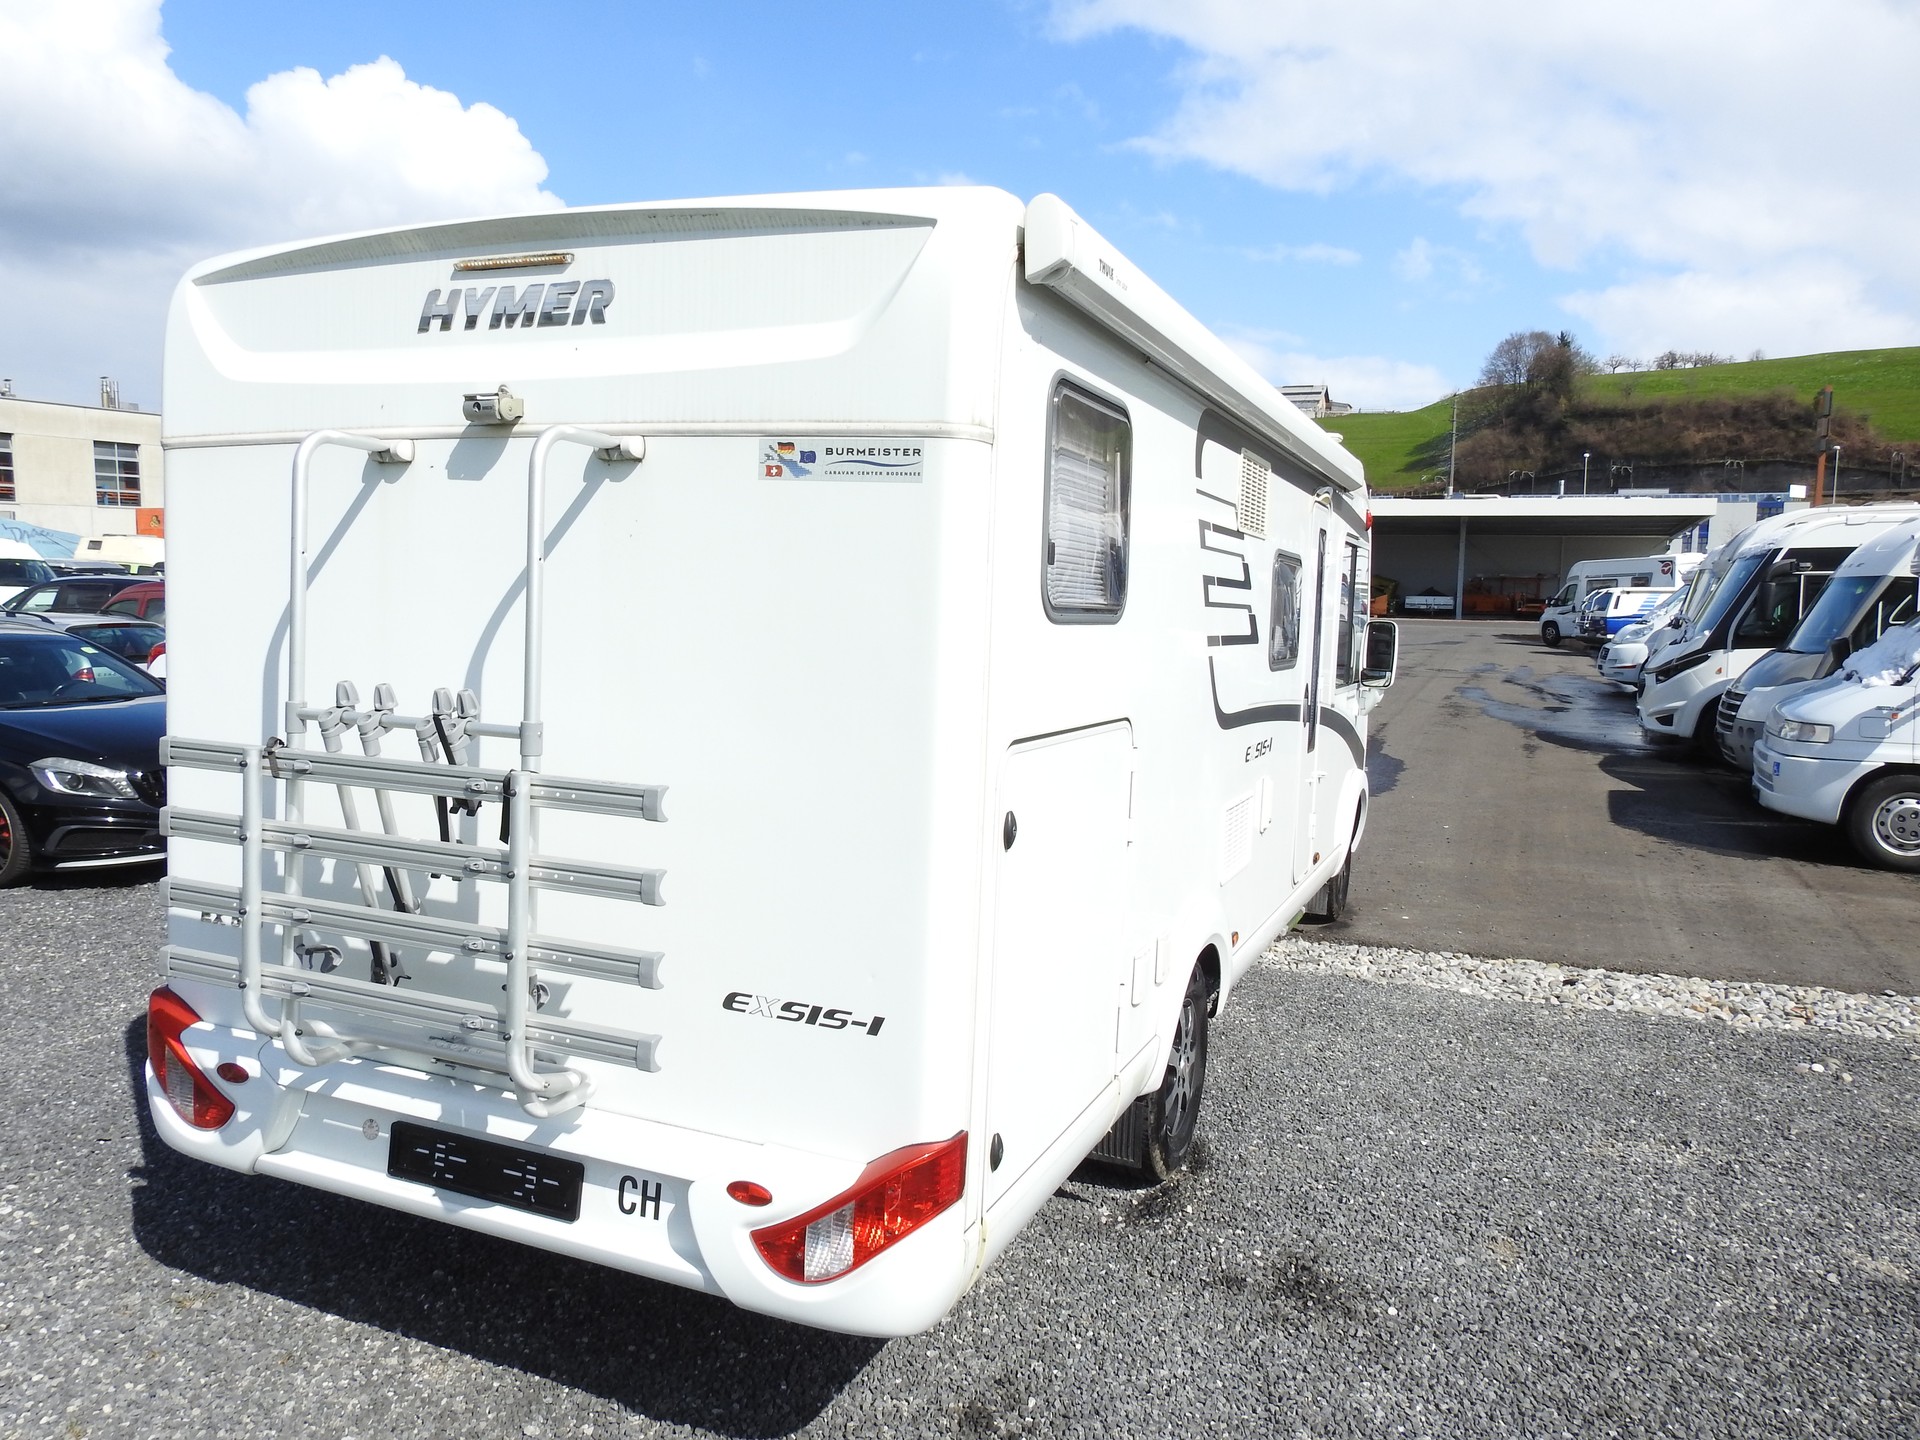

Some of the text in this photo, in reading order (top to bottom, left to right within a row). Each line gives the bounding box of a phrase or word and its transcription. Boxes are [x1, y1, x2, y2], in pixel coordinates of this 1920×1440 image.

[417, 279, 615, 334] HYMER
[825, 447, 922, 457] BURMEISTER
[1244, 736, 1273, 763] ESIS-I
[722, 991, 886, 1037] EXSIS-I
[617, 1174, 662, 1221] CH
